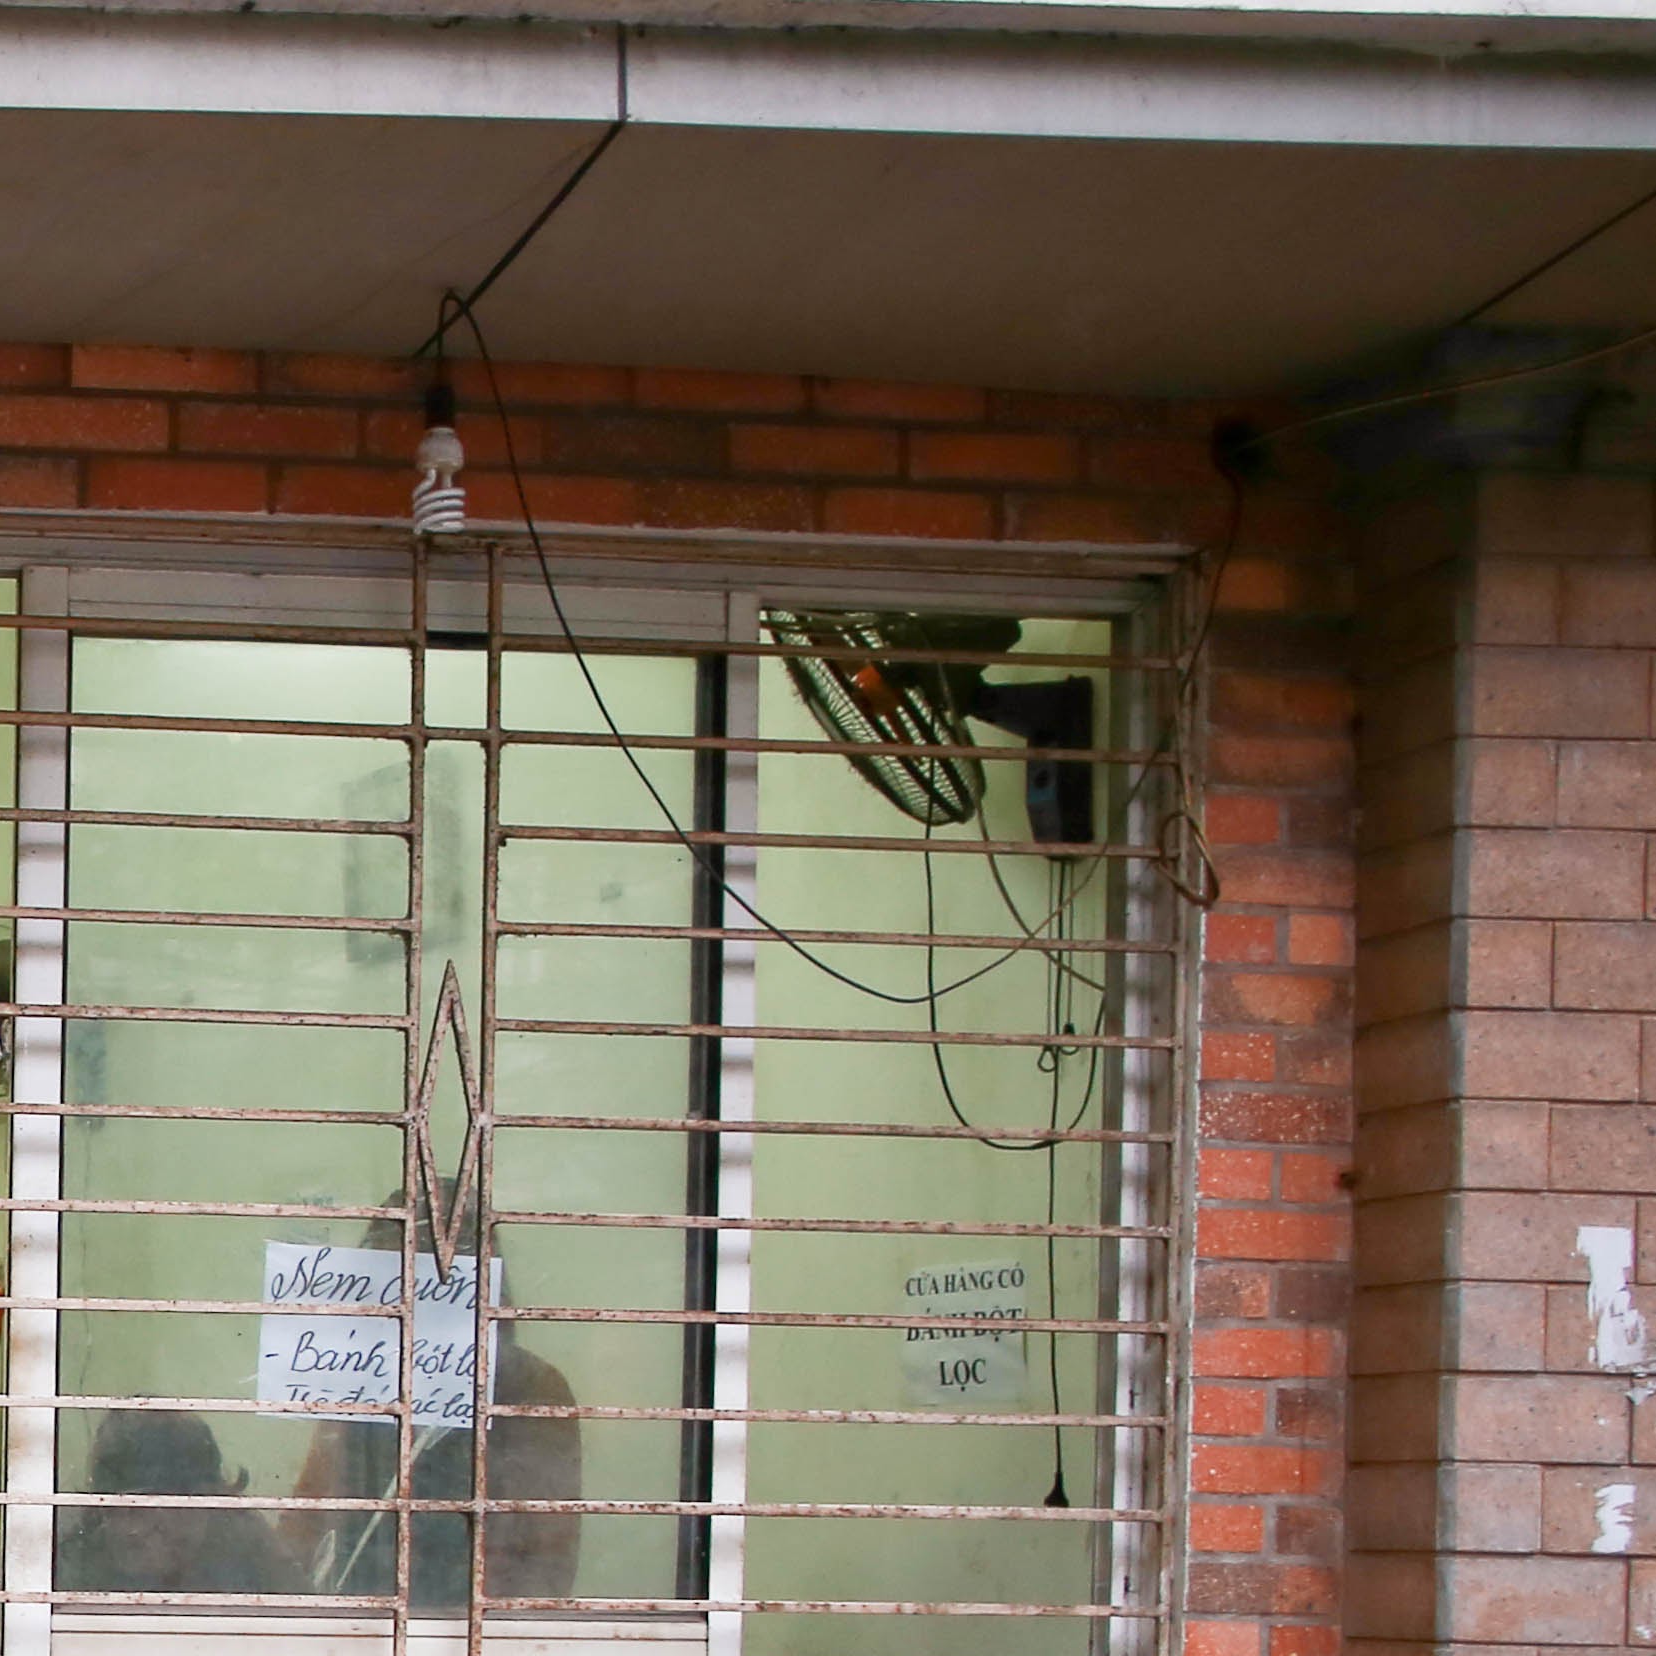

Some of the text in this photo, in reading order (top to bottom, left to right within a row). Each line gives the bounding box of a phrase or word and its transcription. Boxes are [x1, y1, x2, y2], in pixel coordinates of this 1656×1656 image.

[271, 1246, 372, 1303] Nem
[905, 1261, 1025, 1297] CỬA HÀNG CÓ
[290, 1329, 391, 1378] Bánh
[454, 1343, 490, 1385] lọ
[939, 1357, 987, 1392] LỌC
